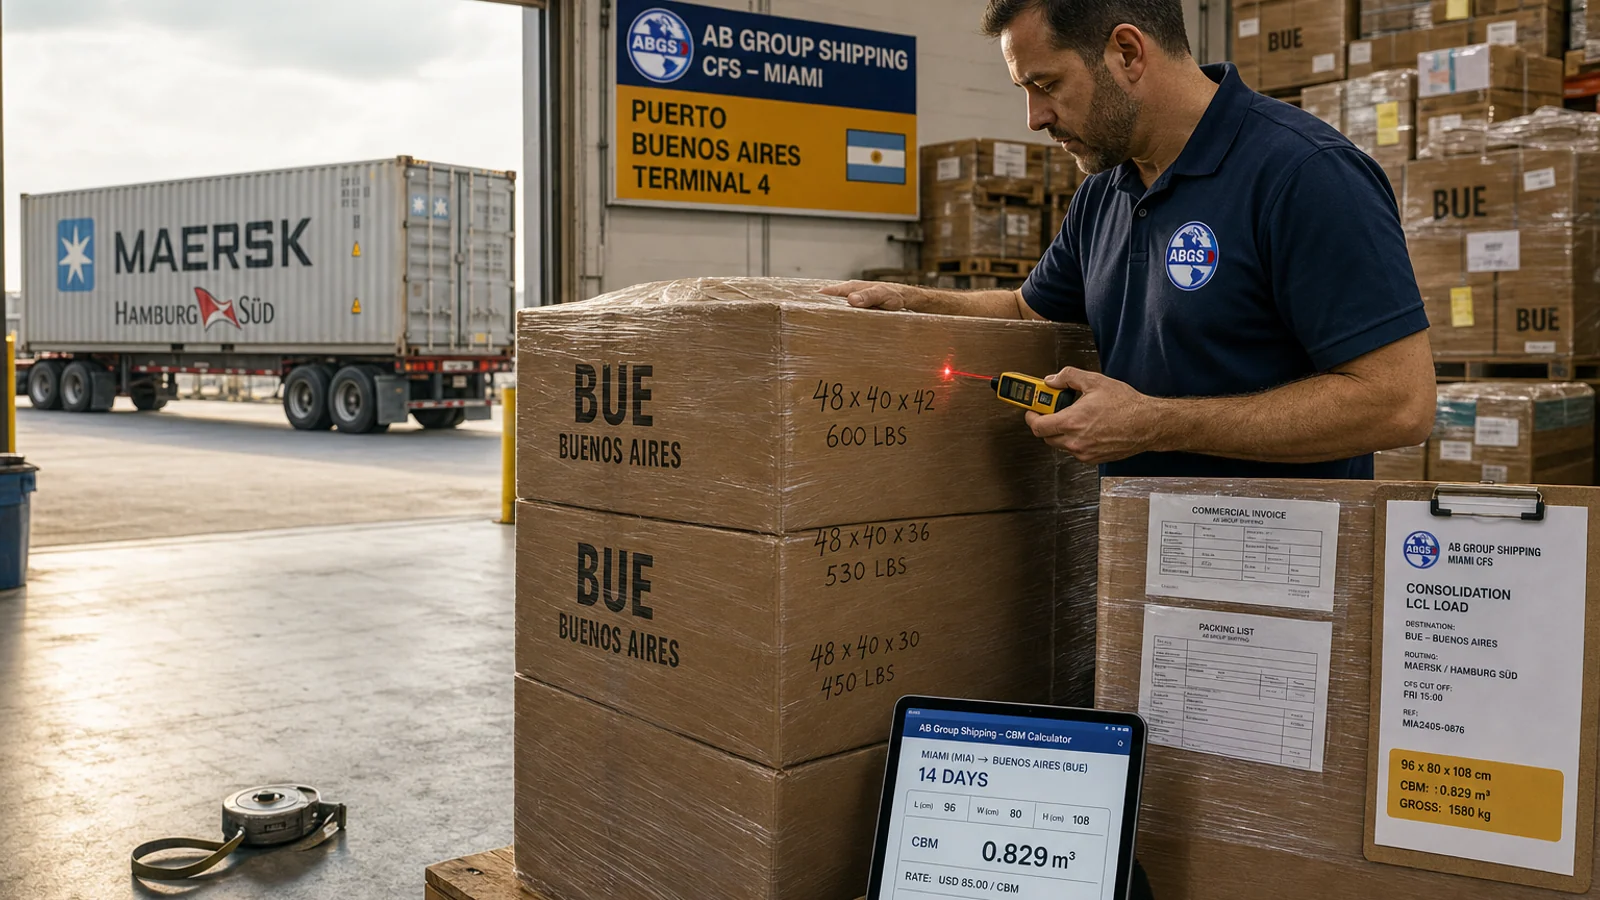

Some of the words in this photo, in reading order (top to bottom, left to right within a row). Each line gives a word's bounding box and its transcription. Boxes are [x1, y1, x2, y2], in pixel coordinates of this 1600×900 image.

[632, 36, 678, 54] ABGS
[702, 24, 733, 48] AB
[740, 29, 814, 58] GROUP
[819, 39, 908, 71] SHIPPING
[1268, 27, 1303, 52] BUE
[702, 55, 741, 79] CFS
[765, 63, 823, 88] MIAMI
[632, 99, 726, 129] PUERTO
[632, 133, 729, 161] BUENOS
[737, 141, 800, 166] AIRES
[633, 166, 751, 194] TERMINAL
[758, 174, 770, 195] 4
[1433, 185, 1487, 219] BUE
[115, 217, 312, 274] MAERSK
[1169, 249, 1204, 263] ABGS
[115, 300, 198, 326] HAMBURG
[1516, 307, 1560, 332] BUE
[575, 363, 653, 427] BUE
[813, 380, 843, 412] 48
[867, 385, 891, 413] 40
[914, 389, 935, 414] 42
[827, 424, 866, 448] 600
[874, 426, 907, 446] LBS
[559, 433, 622, 464] BUENOS
[630, 439, 682, 469] AIRES
[1192, 507, 1250, 517] COMMERCIAL
[1252, 509, 1286, 519] INVOICE
[814, 527, 841, 556] 48
[863, 525, 886, 549] 40
[908, 522, 930, 543] 36
[1448, 543, 1460, 552] AB
[1463, 544, 1495, 554] GROUP
[1497, 546, 1541, 556] SHIPPING
[825, 561, 865, 587] 530
[875, 557, 907, 577] LBS
[1448, 556, 1474, 565] MIAMI
[1476, 557, 1493, 566] CFS
[577, 542, 653, 620] BUE
[1406, 583, 1511, 600] CONSOLIDATION
[1406, 598, 1430, 609] LCL
[1434, 600, 1469, 613] LOAD
[559, 613, 621, 654] BUENOS
[628, 630, 680, 668] AIRES
[1199, 623, 1235, 633] PACKING
[1237, 627, 1254, 636] LIST
[1405, 632, 1423, 641] BUE
[1432, 634, 1469, 645] BUENOS
[1471, 638, 1498, 648] AIRES
[810, 641, 835, 672] 48
[857, 635, 879, 660] 40
[899, 631, 920, 650] 30
[1405, 651, 1438, 660] ROUTING:
[821, 672, 856, 700] 450
[865, 664, 895, 687] LBS
[1405, 662, 1442, 673] MAERSK
[1450, 666, 1496, 678] HAMBURG
[1404, 690, 1418, 699] FRI
[1420, 692, 1443, 702] 15:00
[1420, 682, 1434, 690] CUT
[1436, 684, 1452, 692] OFF:
[919, 723, 931, 732] AB
[933, 724, 959, 736] Group
[961, 726, 997, 739] Shipping
[1005, 730, 1026, 740] CBM
[1028, 732, 1072, 744] Calculator
[921, 750, 949, 761] MIAMI
[951, 752, 975, 764] (MIA)
[992, 756, 1031, 768] BUENOS
[1033, 760, 1060, 771] AIRES
[1063, 762, 1088, 774] (BUE)
[1401, 759, 1415, 771] 96
[1418, 763, 1424, 772] x
[1427, 762, 1441, 774] 80
[1444, 767, 1450, 775] x
[1453, 766, 1472, 778] 108
[1475, 771, 1492, 781] cm
[919, 767, 936, 783] 14
[942, 769, 989, 788] DAYS
[1400, 780, 1429, 793] CBM:
[920, 802, 934, 810] (cm)
[944, 803, 956, 812] 96
[985, 808, 999, 816] (cm)
[1009, 809, 1022, 819] 80
[1399, 798, 1442, 813] GROSS:
[1449, 804, 1474, 817] 1580
[1478, 808, 1491, 822] kg
[1043, 813, 1049, 821] H
[1050, 814, 1064, 823] (cm)
[1073, 815, 1090, 826] 108
[911, 836, 939, 849] CBM
[982, 840, 1048, 868] 0.829
[1052, 851, 1076, 869] m³
[905, 871, 932, 883] RATE:
[939, 875, 959, 886] USD
[961, 878, 988, 890] 85.00
[989, 882, 995, 891] /
[997, 882, 1019, 893] CBM
